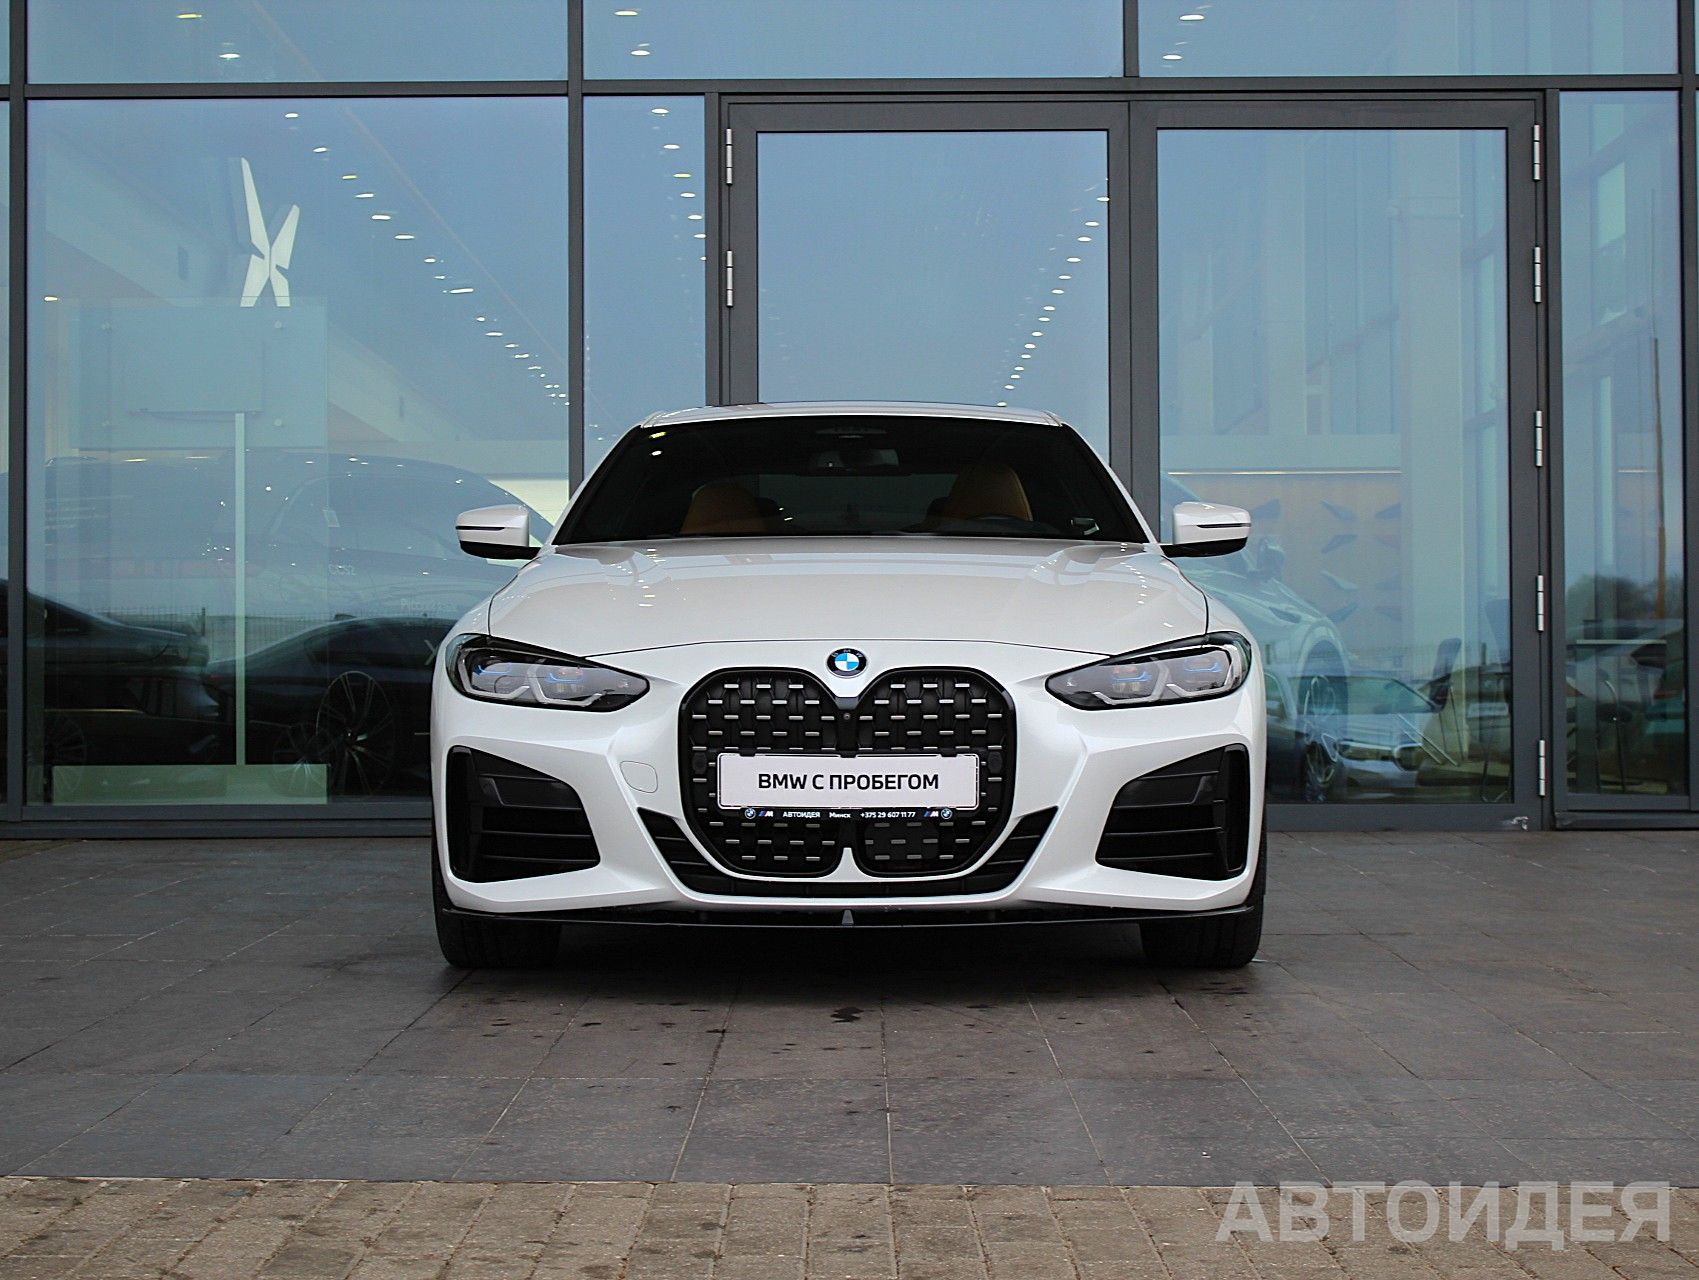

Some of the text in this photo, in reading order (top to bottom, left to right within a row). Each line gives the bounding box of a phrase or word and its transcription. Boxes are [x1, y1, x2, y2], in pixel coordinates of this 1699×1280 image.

[758, 773, 939, 790] BMW С ПРОБЕГОМ
